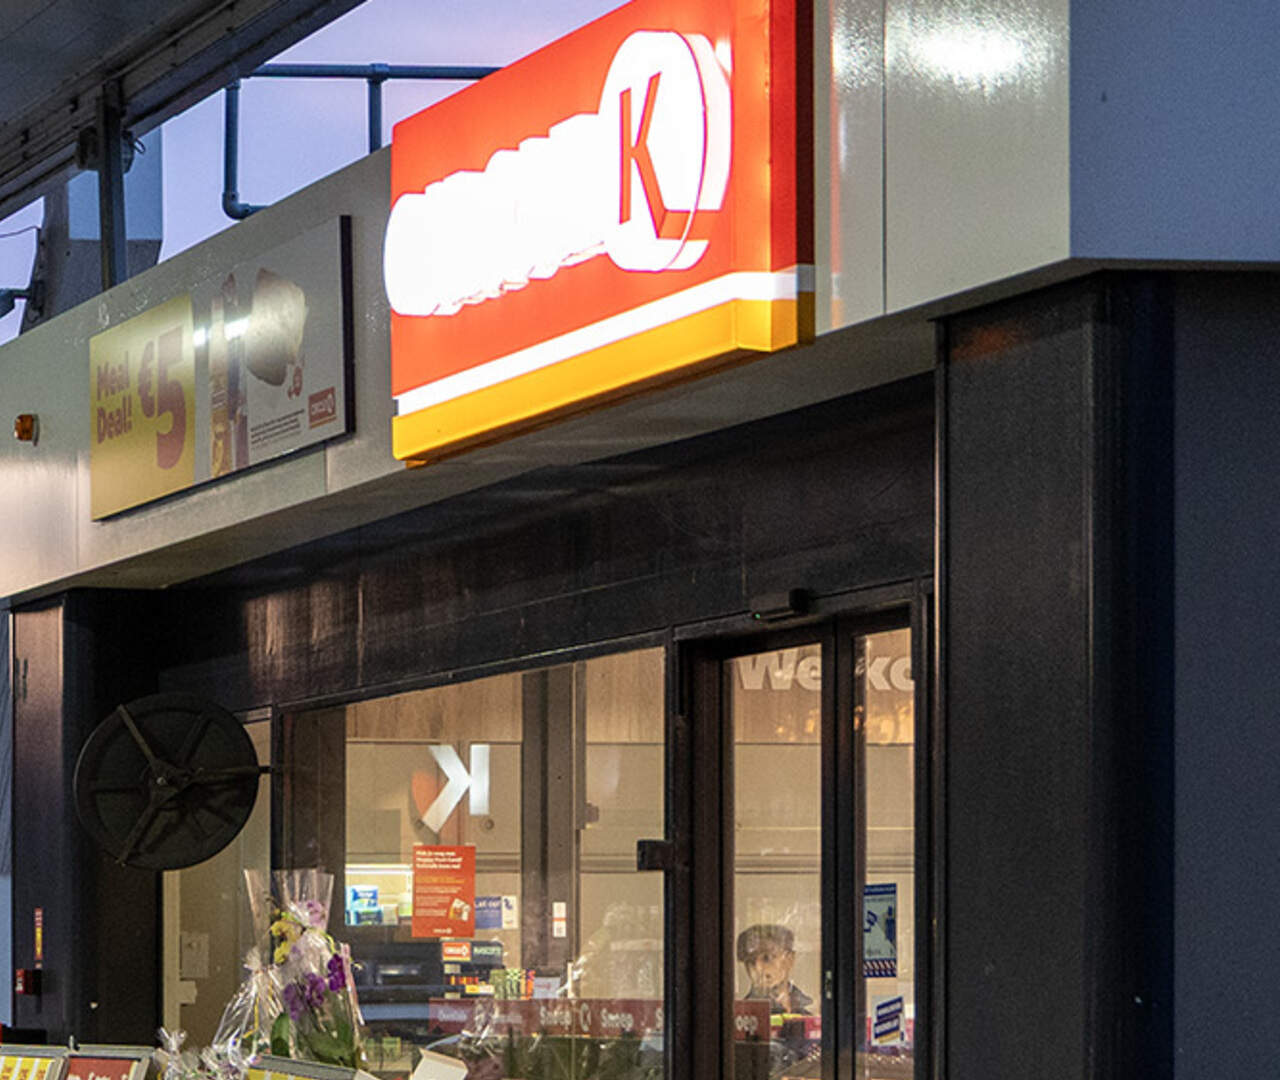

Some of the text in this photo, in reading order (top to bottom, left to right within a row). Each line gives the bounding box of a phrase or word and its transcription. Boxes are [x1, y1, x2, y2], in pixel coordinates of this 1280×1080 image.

[96, 350, 130, 400] Meal
[137, 325, 187, 470] €5
[96, 394, 133, 444] Deal!
